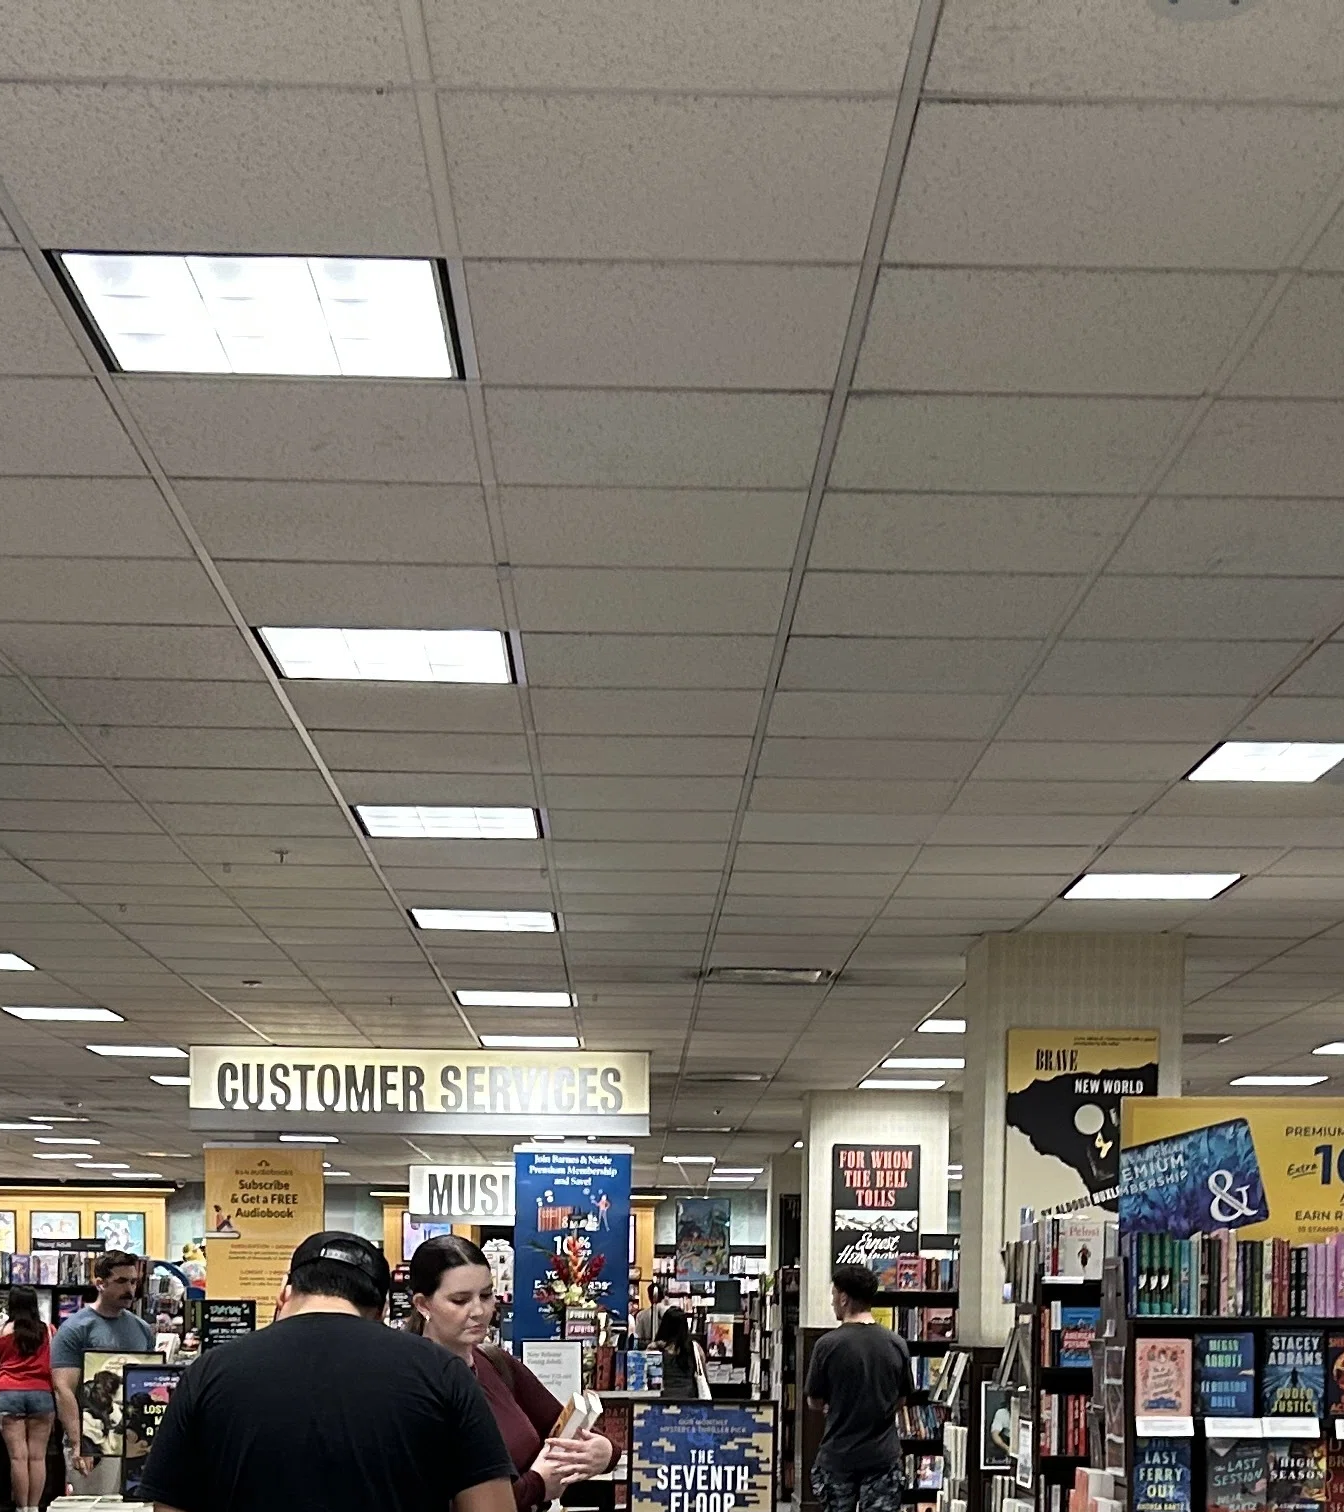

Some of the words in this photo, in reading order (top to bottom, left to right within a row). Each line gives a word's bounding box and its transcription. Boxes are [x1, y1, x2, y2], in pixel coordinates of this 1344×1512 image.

[1036, 1049, 1078, 1071] BRAVE
[218, 1062, 424, 1112] CUSTOMER
[441, 1066, 623, 1113] SERVICES
[1074, 1079, 1100, 1095] NEW
[1103, 1079, 1144, 1095] WORLD
[535, 1155, 551, 1165] Join
[553, 1155, 579, 1164] Barnes
[580, 1155, 587, 1164] &
[588, 1155, 612, 1165] Noble
[839, 1150, 865, 1169] FOR
[870, 1150, 913, 1170] WHOM
[529, 1166, 566, 1175] Premium
[569, 1166, 618, 1177] Membership
[1287, 1162, 1318, 1178] Extra
[239, 1180, 290, 1190] Subscribe
[554, 1177, 569, 1185] and
[571, 1177, 592, 1185] Save!
[844, 1170, 871, 1188] THE
[876, 1170, 908, 1188] BELL
[231, 1194, 239, 1204] &
[241, 1194, 260, 1204] Get
[262, 1196, 269, 1204] a
[271, 1194, 298, 1204] FREE
[429, 1173, 509, 1216] MUSI
[855, 1189, 896, 1207] TOLLS
[235, 1208, 294, 1219] Audiobook
[1295, 1210, 1331, 1221] EARN
[855, 1232, 900, 1254] Ernest
[1272, 1337, 1319, 1350] STACEY
[1268, 1352, 1323, 1365] ABRAMS
[690, 1450, 714, 1464] THE
[1145, 1452, 1177, 1465] LAST
[1227, 1457, 1257, 1472] LAST
[657, 1465, 749, 1491] SEVENTH
[1139, 1468, 1182, 1482] FERRY
[1214, 1469, 1263, 1486] SESSION
[1147, 1484, 1175, 1498] OUT
